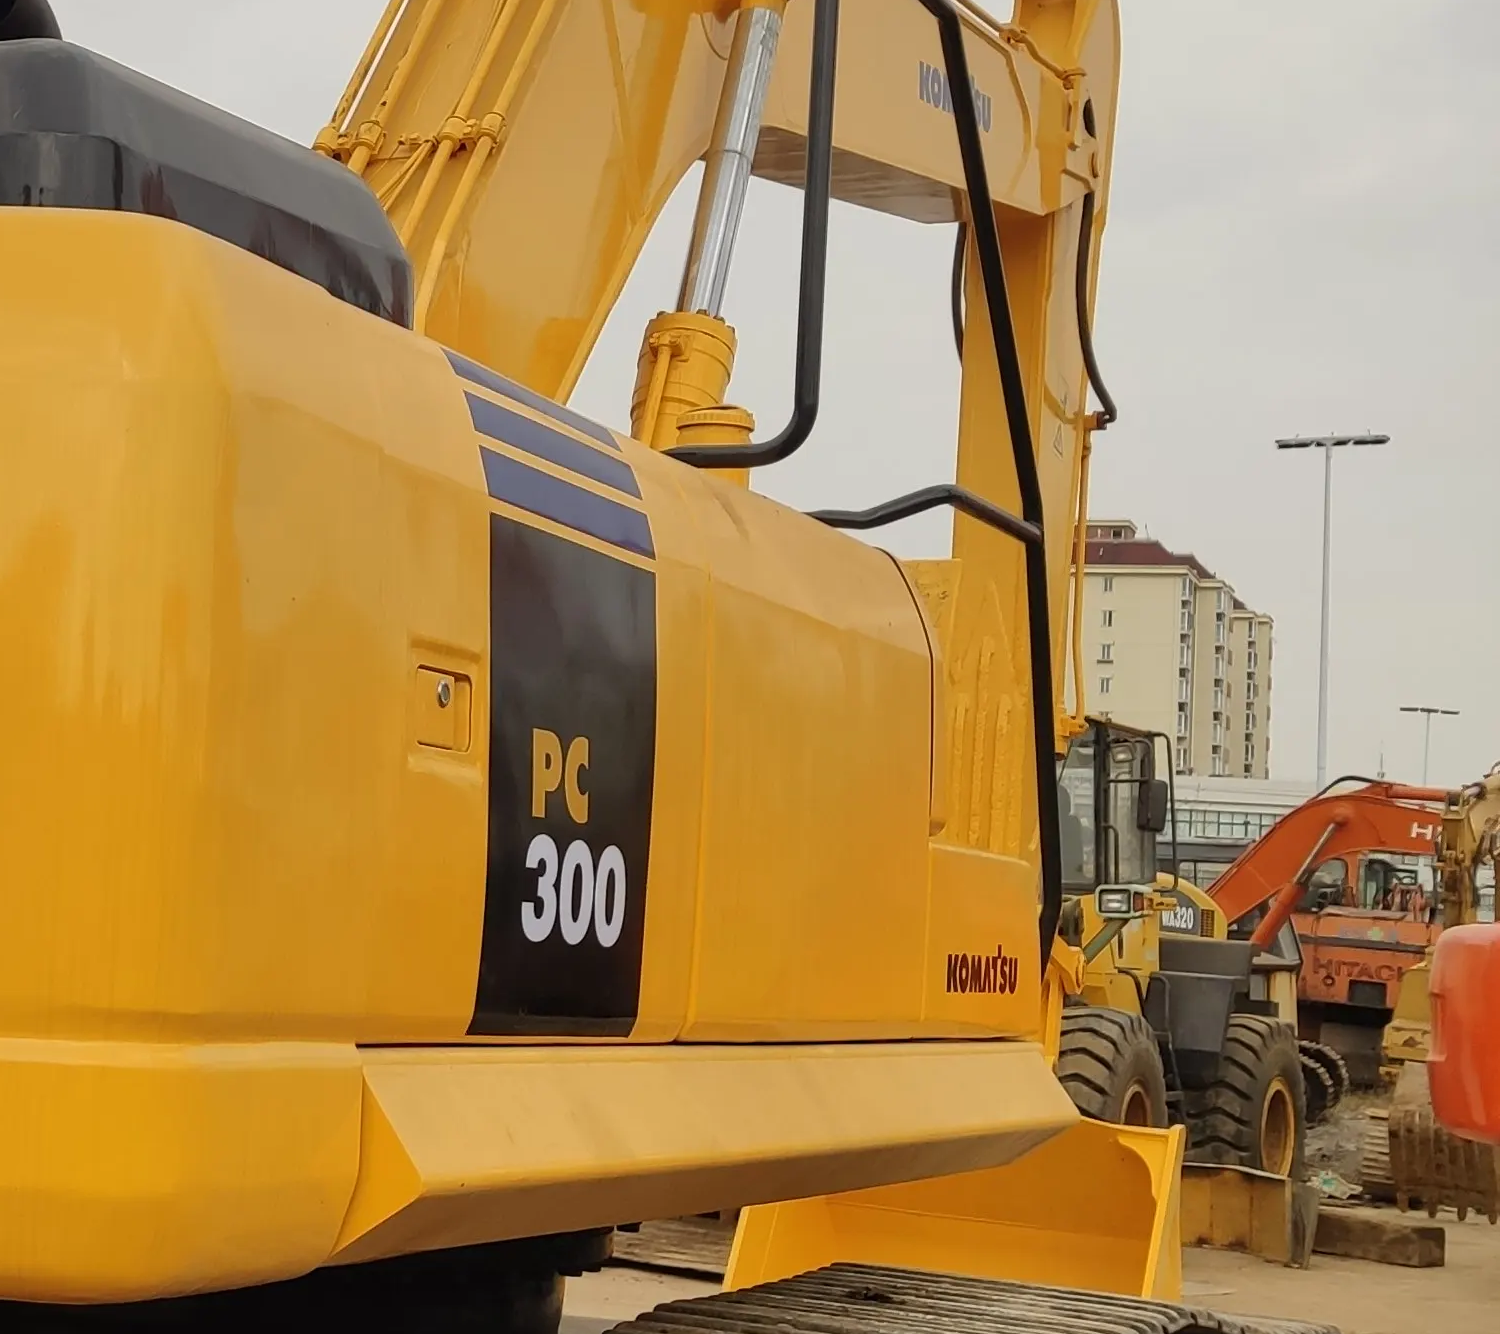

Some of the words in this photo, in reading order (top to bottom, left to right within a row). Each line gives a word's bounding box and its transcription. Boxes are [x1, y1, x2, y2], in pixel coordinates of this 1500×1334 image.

[532, 728, 589, 824] PC
[521, 833, 626, 948] 300
[946, 943, 1018, 995] KOMATSU
[1313, 956, 1403, 983] HITAC
